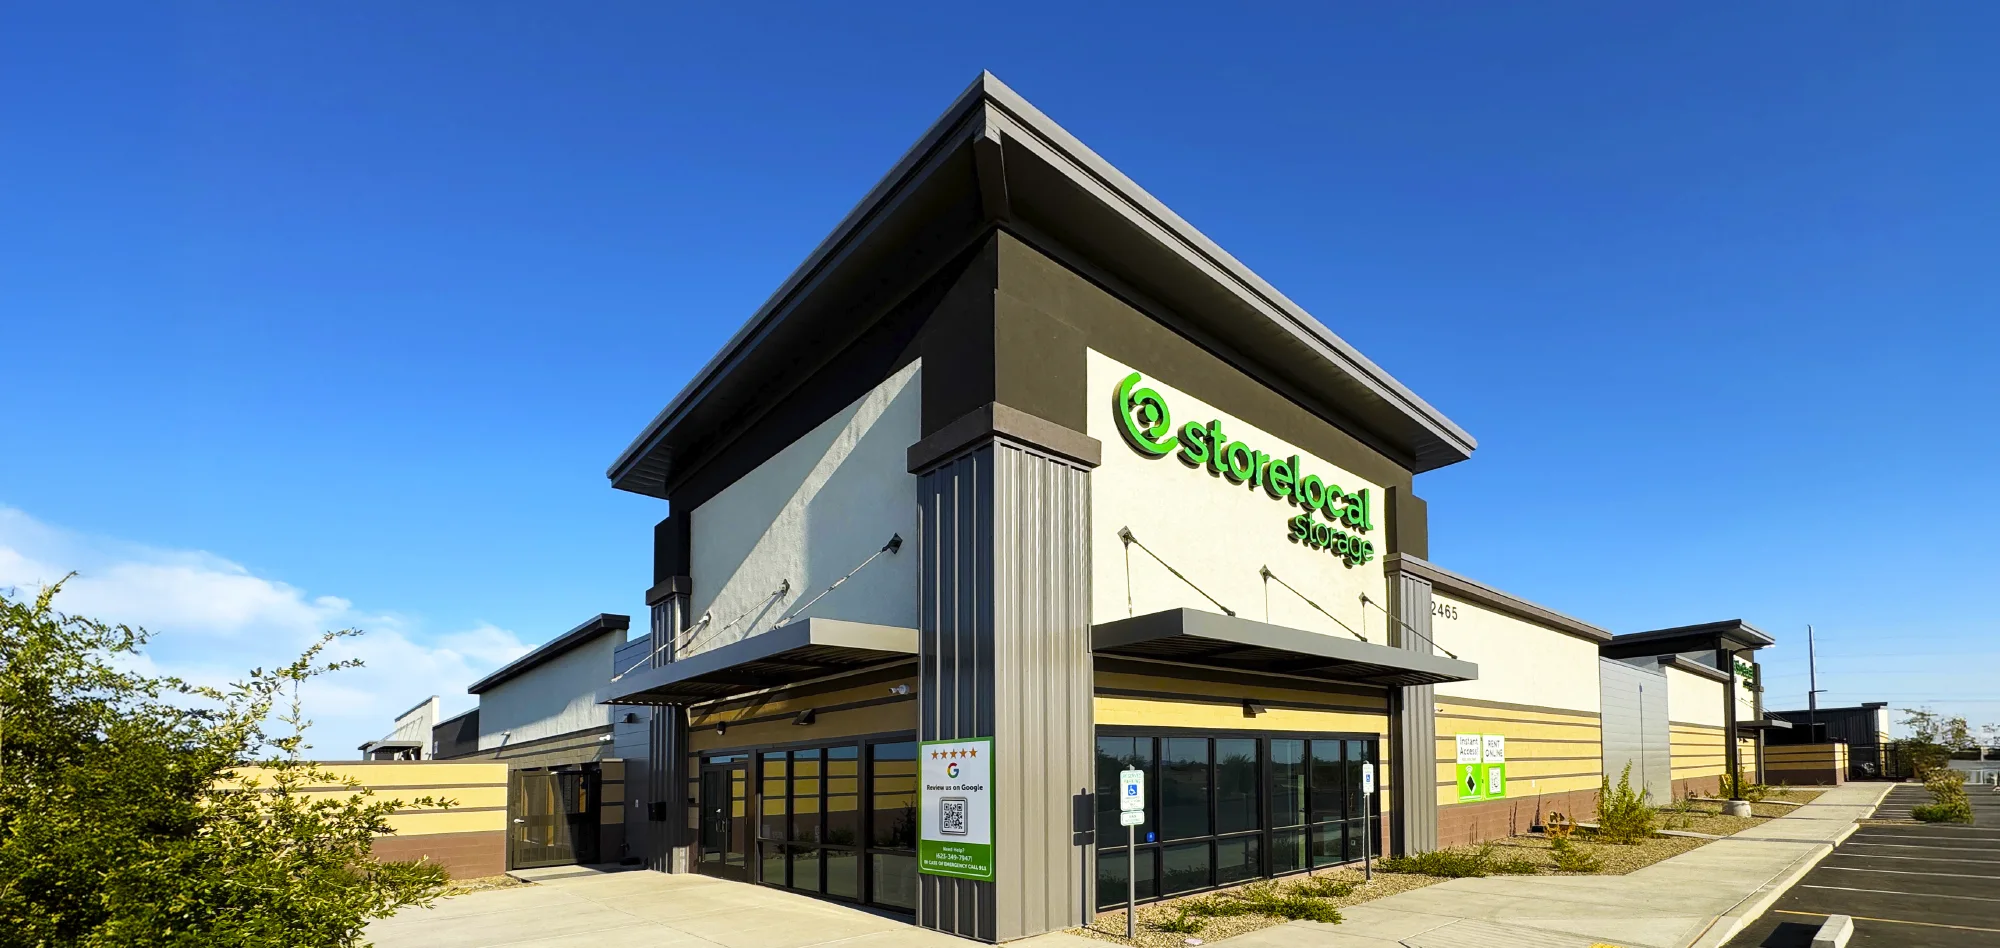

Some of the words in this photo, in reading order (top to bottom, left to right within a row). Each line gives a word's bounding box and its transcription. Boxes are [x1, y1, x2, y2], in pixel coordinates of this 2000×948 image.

[1180, 419, 1374, 531] storelocal
[1291, 513, 1374, 566] storage
[1459, 736, 1478, 745] Instant
[1487, 739, 1500, 748] RENT
[1485, 749, 1503, 757] ONLINE
[961, 784, 983, 792] Google
